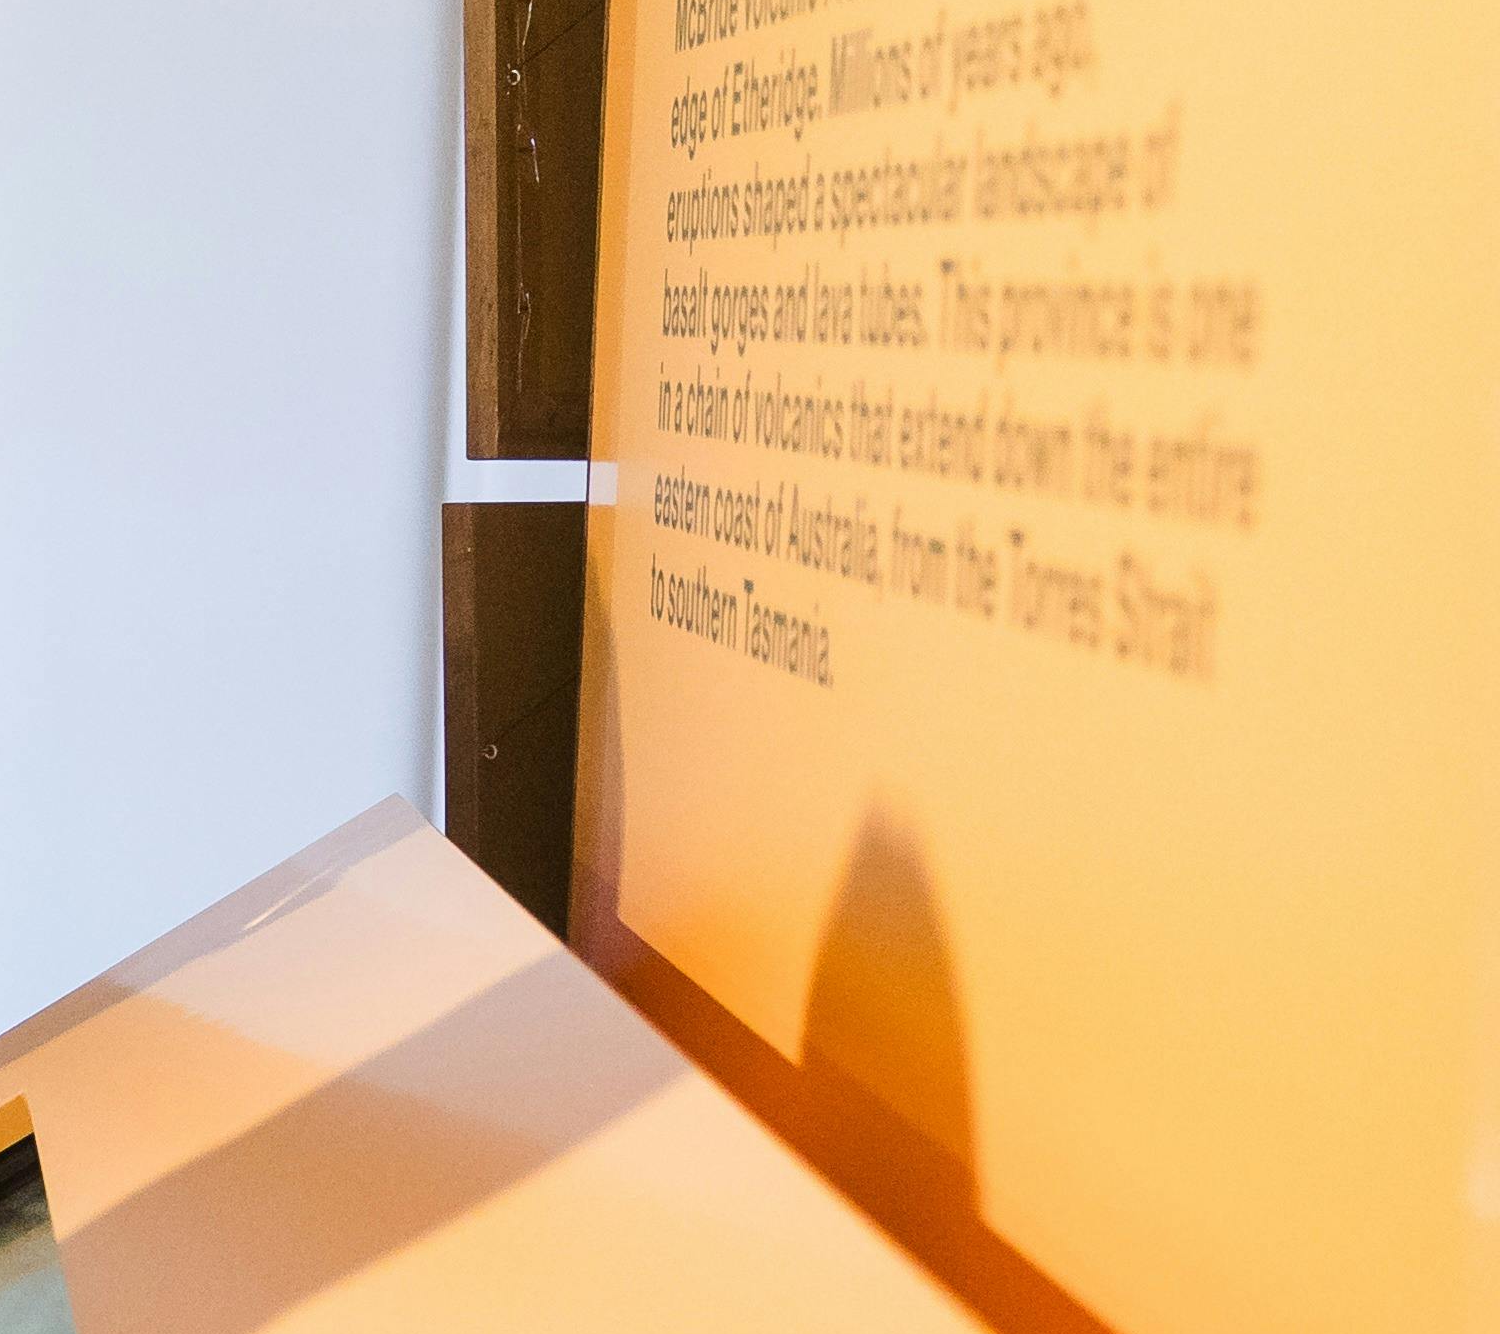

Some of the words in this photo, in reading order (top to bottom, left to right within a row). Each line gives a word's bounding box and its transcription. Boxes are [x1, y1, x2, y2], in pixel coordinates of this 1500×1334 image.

[670, 72, 708, 162] edge
[710, 61, 729, 140] of
[730, 42, 822, 143] Etheridge.
[827, 20, 914, 117] Millions
[917, 0, 948, 99] of
[666, 164, 740, 257] eruptions
[742, 147, 810, 252] shaped
[813, 162, 825, 230] a
[830, 124, 968, 248] spectacular
[662, 263, 708, 338] basalt
[709, 277, 770, 358] gorges
[772, 257, 810, 342] and
[812, 257, 853, 344] lava
[657, 357, 672, 430] in
[673, 373, 683, 432] a
[685, 359, 729, 439] chain
[731, 362, 751, 443] of
[752, 364, 846, 458] volcanics
[848, 370, 893, 465] that
[653, 457, 711, 537] eastern
[712, 471, 761, 550] coast
[763, 471, 784, 557] of
[889, 493, 947, 602] from
[649, 546, 665, 620] to
[667, 558, 738, 649] southern
[741, 570, 833, 688] Tasmania.
